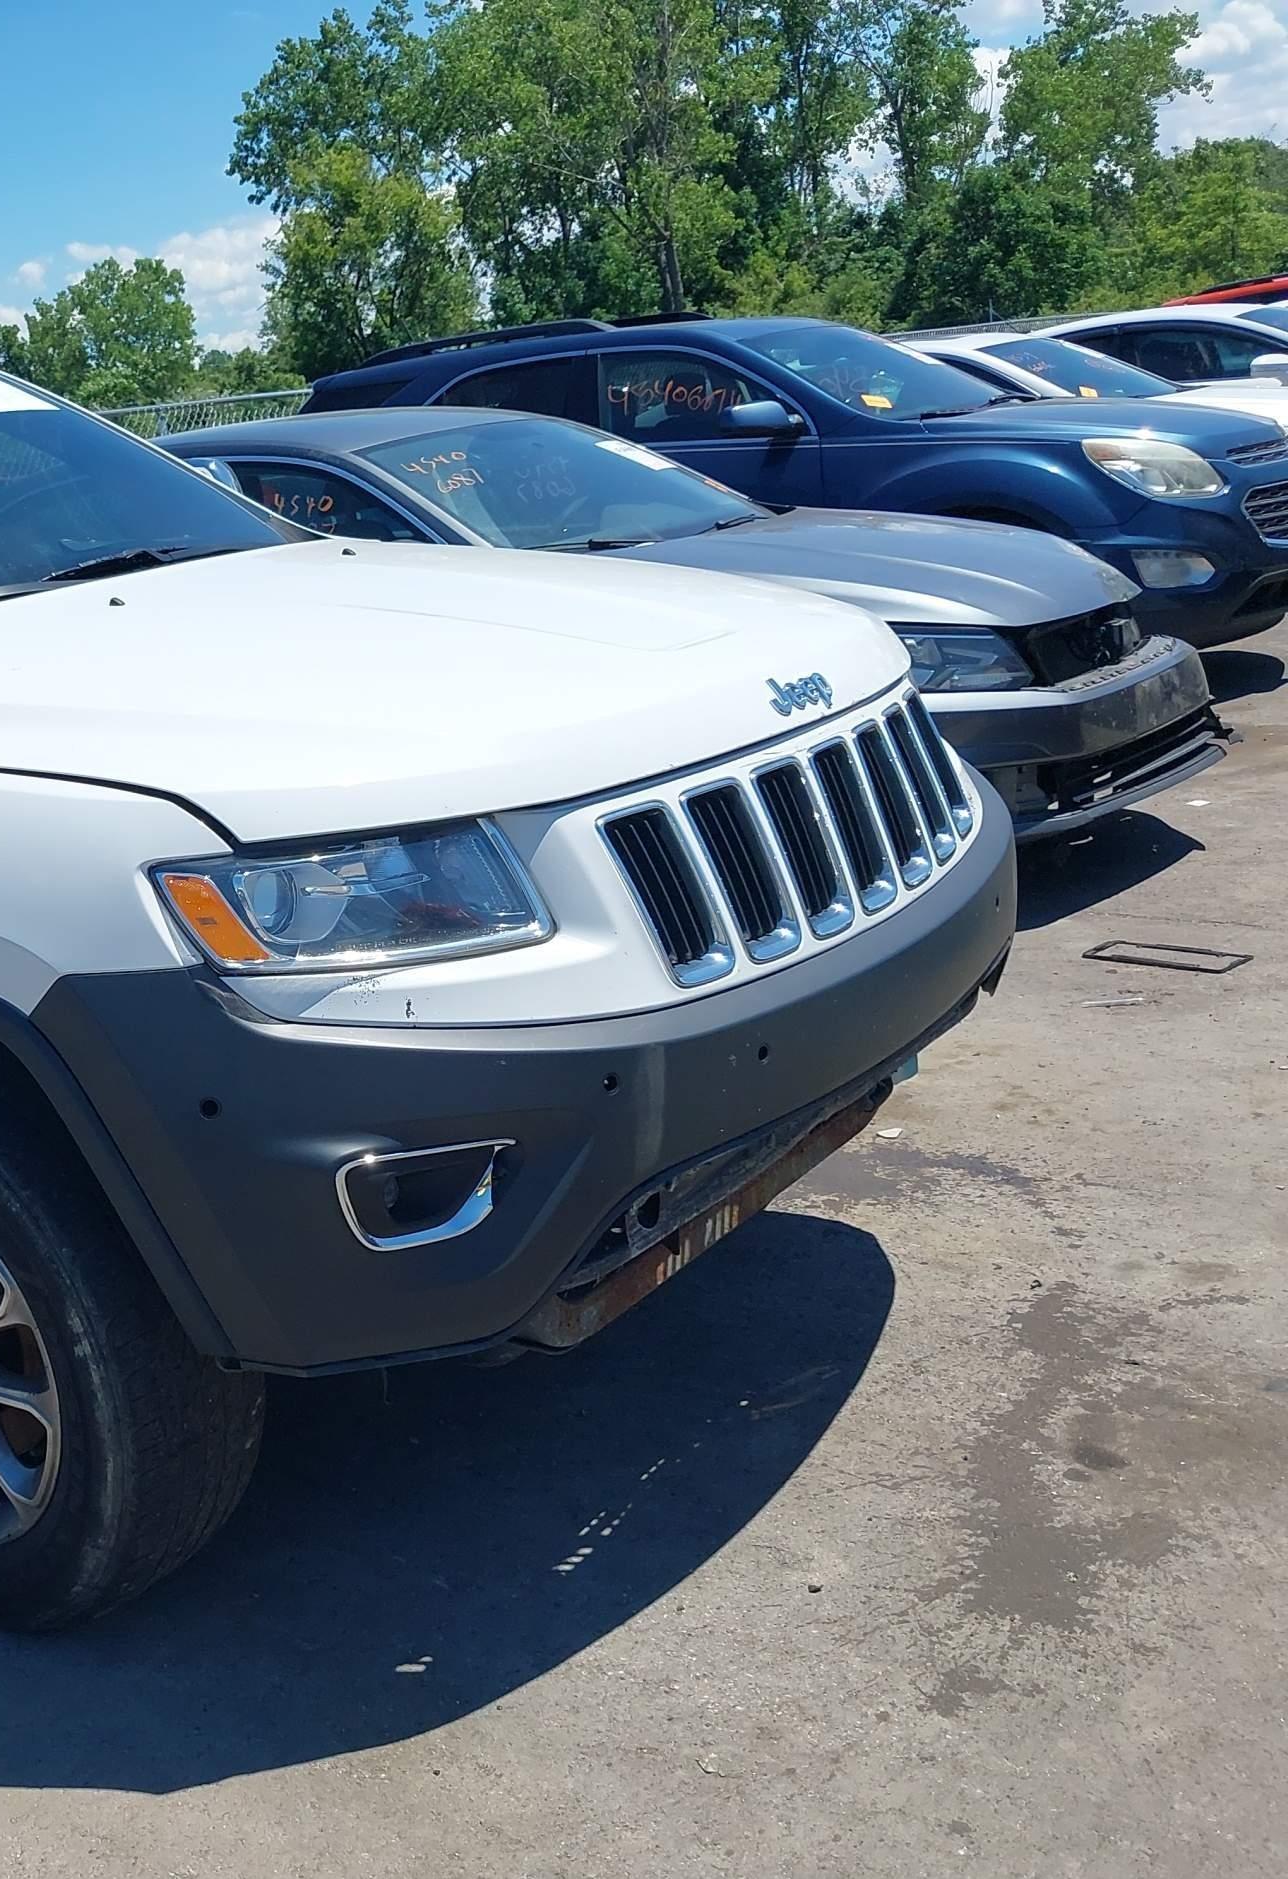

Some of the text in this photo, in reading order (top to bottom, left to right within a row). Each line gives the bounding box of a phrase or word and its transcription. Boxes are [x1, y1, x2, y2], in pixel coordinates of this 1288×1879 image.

[400, 451, 467, 474] 4540
[437, 468, 485, 493] 6087
[274, 493, 334, 518] 4540
[765, 672, 833, 716] Jeep
